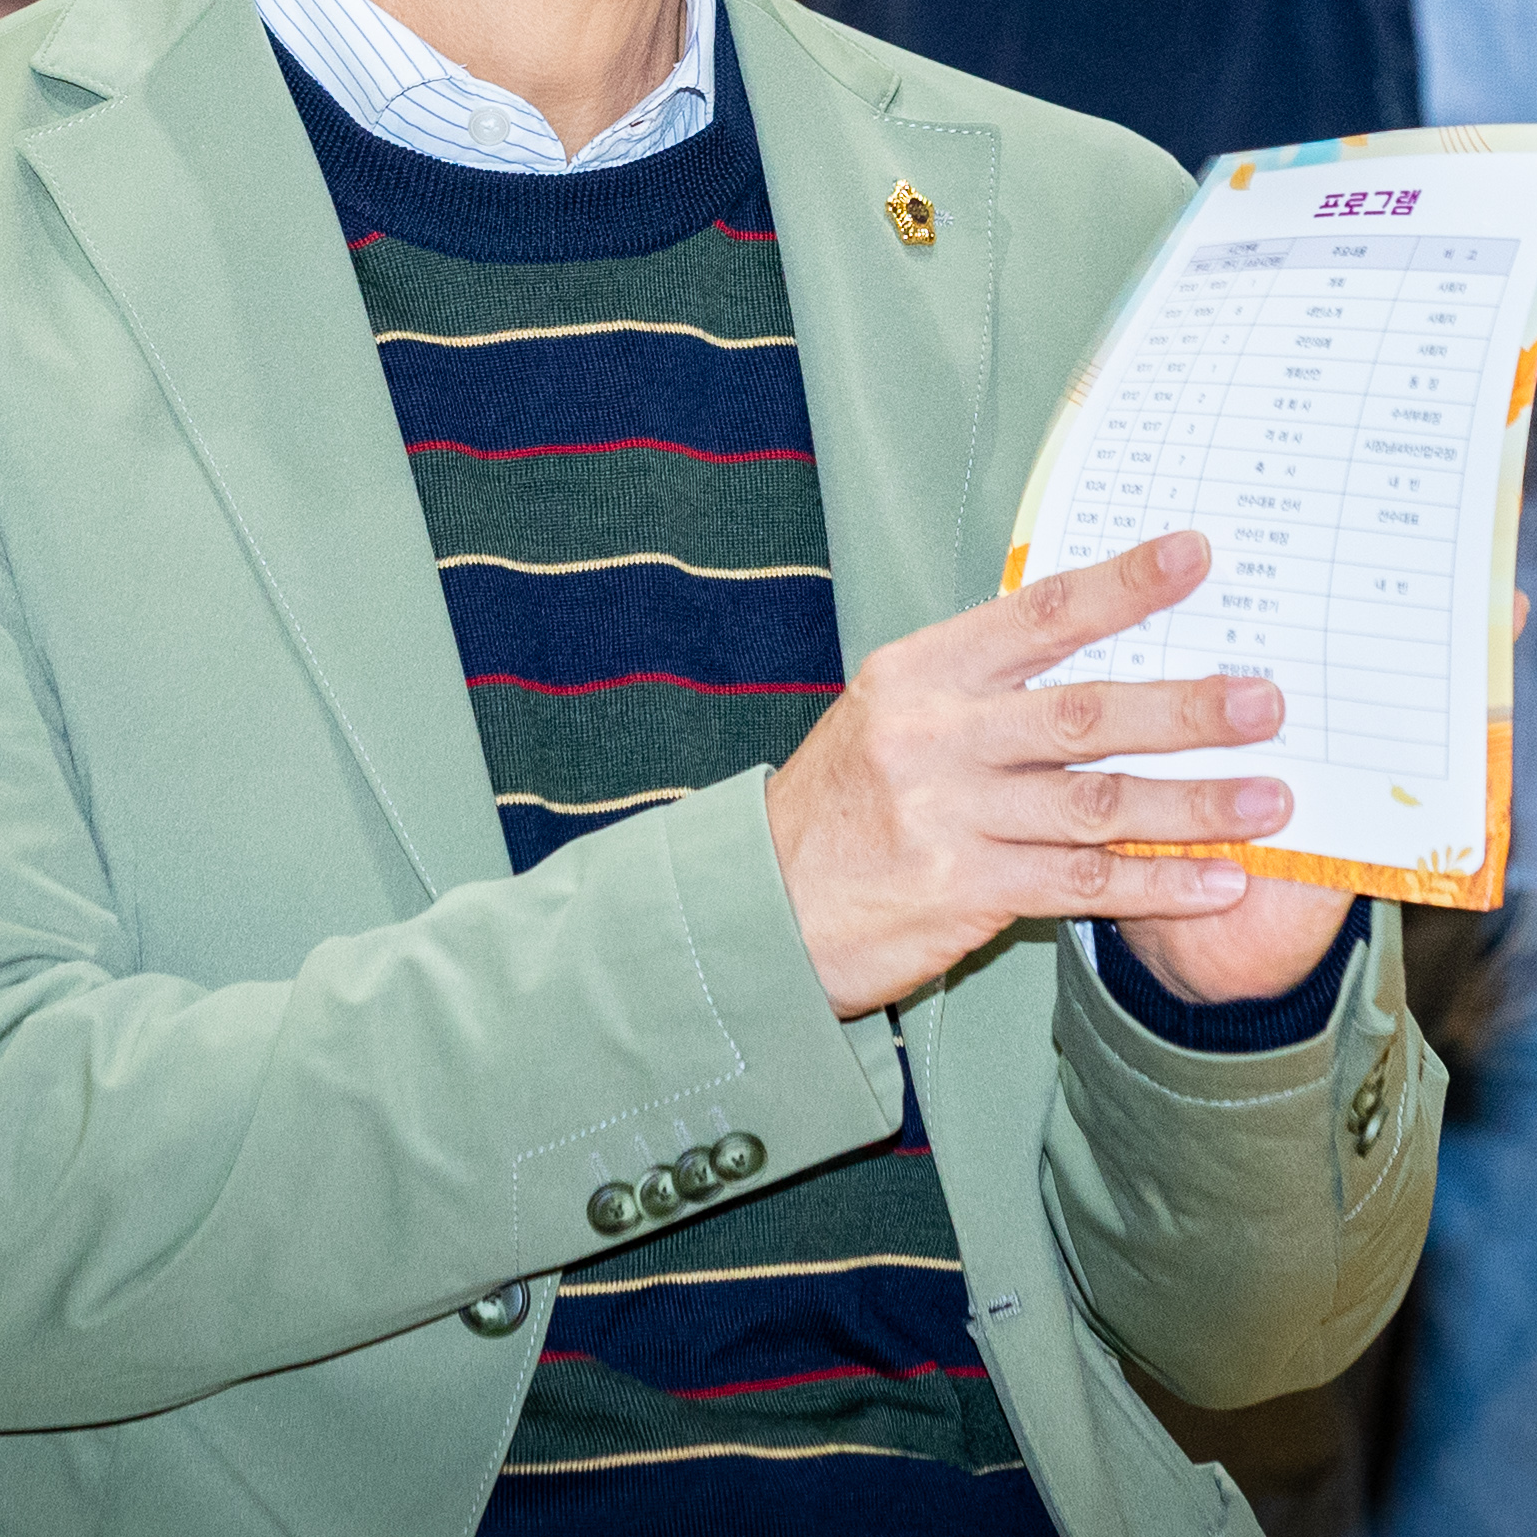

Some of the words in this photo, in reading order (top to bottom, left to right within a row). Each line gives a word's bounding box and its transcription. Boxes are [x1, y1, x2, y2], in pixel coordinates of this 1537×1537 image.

[1313, 189, 1422, 219] 프로그램
[1438, 281, 1467, 293] 사회자
[1428, 312, 1456, 324] 사회자
[1418, 344, 1448, 357] 사회자
[1237, 494, 1276, 509] 선수대표
[1280, 498, 1302, 512] 선서
[1378, 510, 1420, 526] 선수대표
[1234, 527, 1265, 543] 선수단
[1268, 531, 1290, 545] 퇴장
[1236, 561, 1277, 577] 경품추첨
[1257, 598, 1279, 612] 경기
